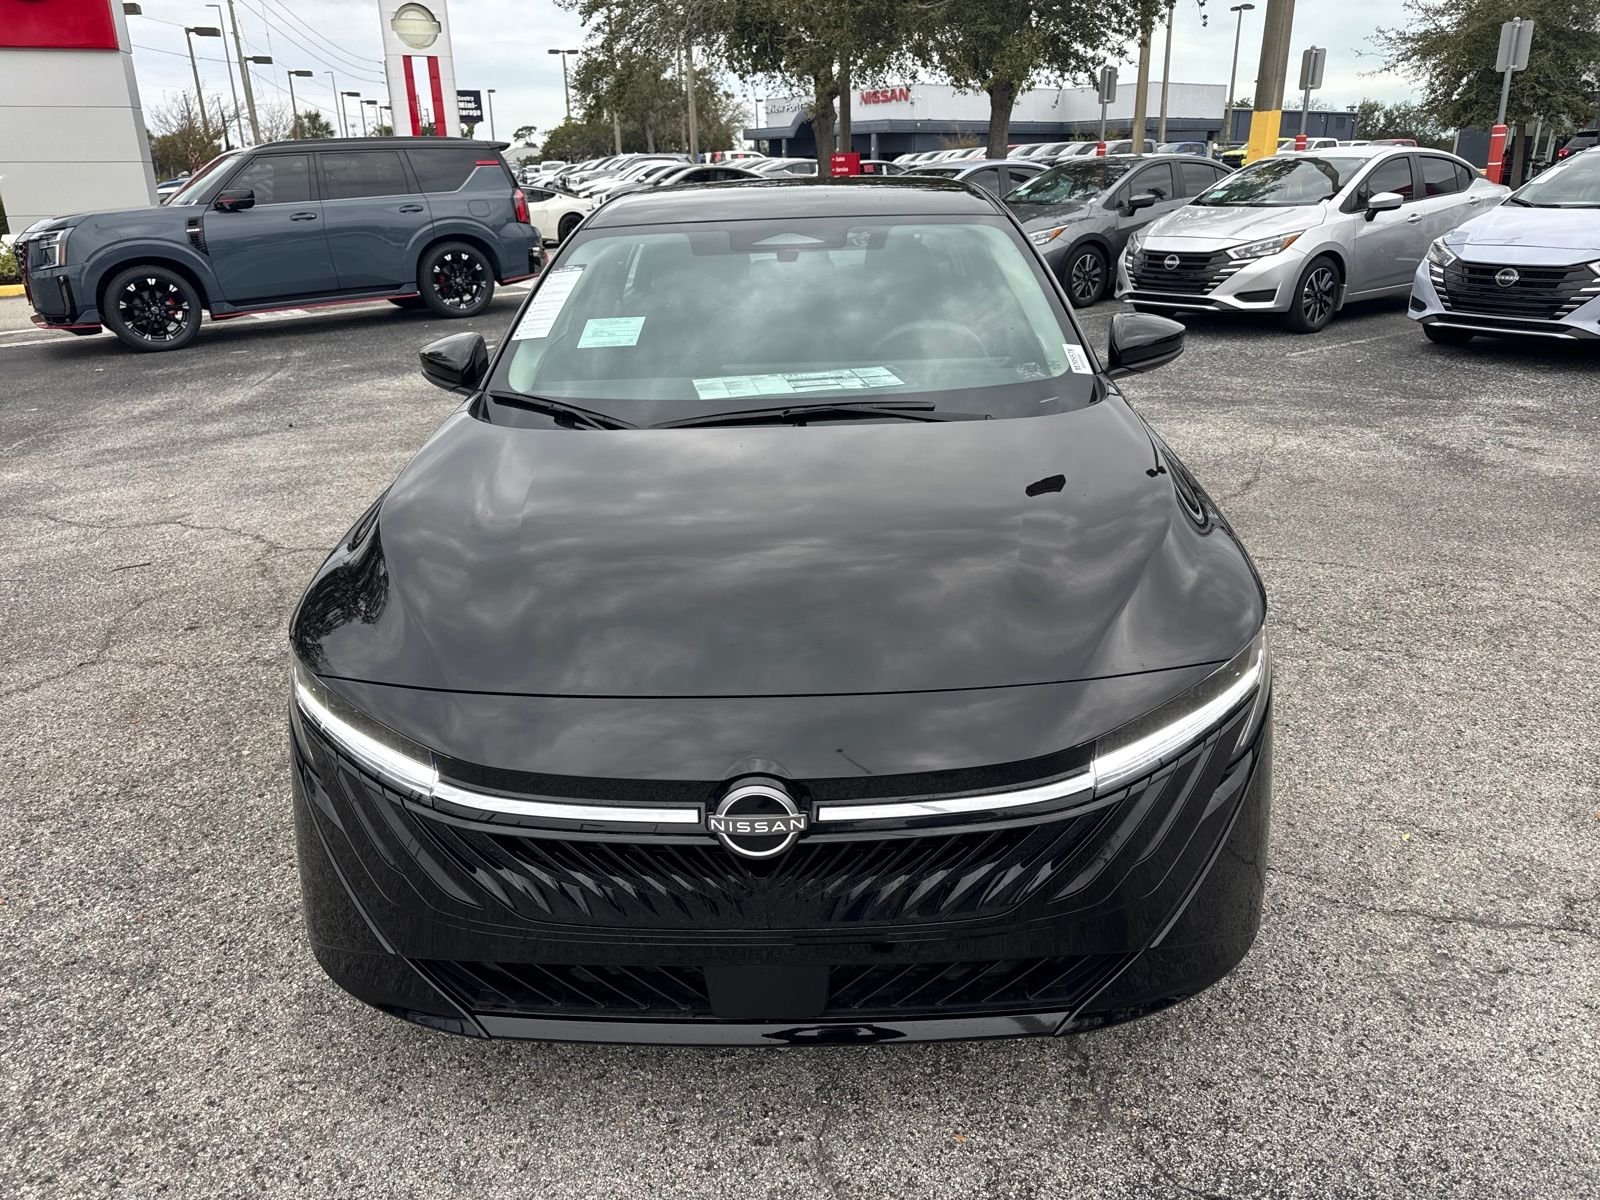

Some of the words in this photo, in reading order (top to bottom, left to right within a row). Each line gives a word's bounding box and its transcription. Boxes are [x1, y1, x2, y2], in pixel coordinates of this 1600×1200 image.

[861, 88, 910, 105] NISSAN
[459, 109, 481, 117] torage
[710, 818, 804, 832] NISSAN
